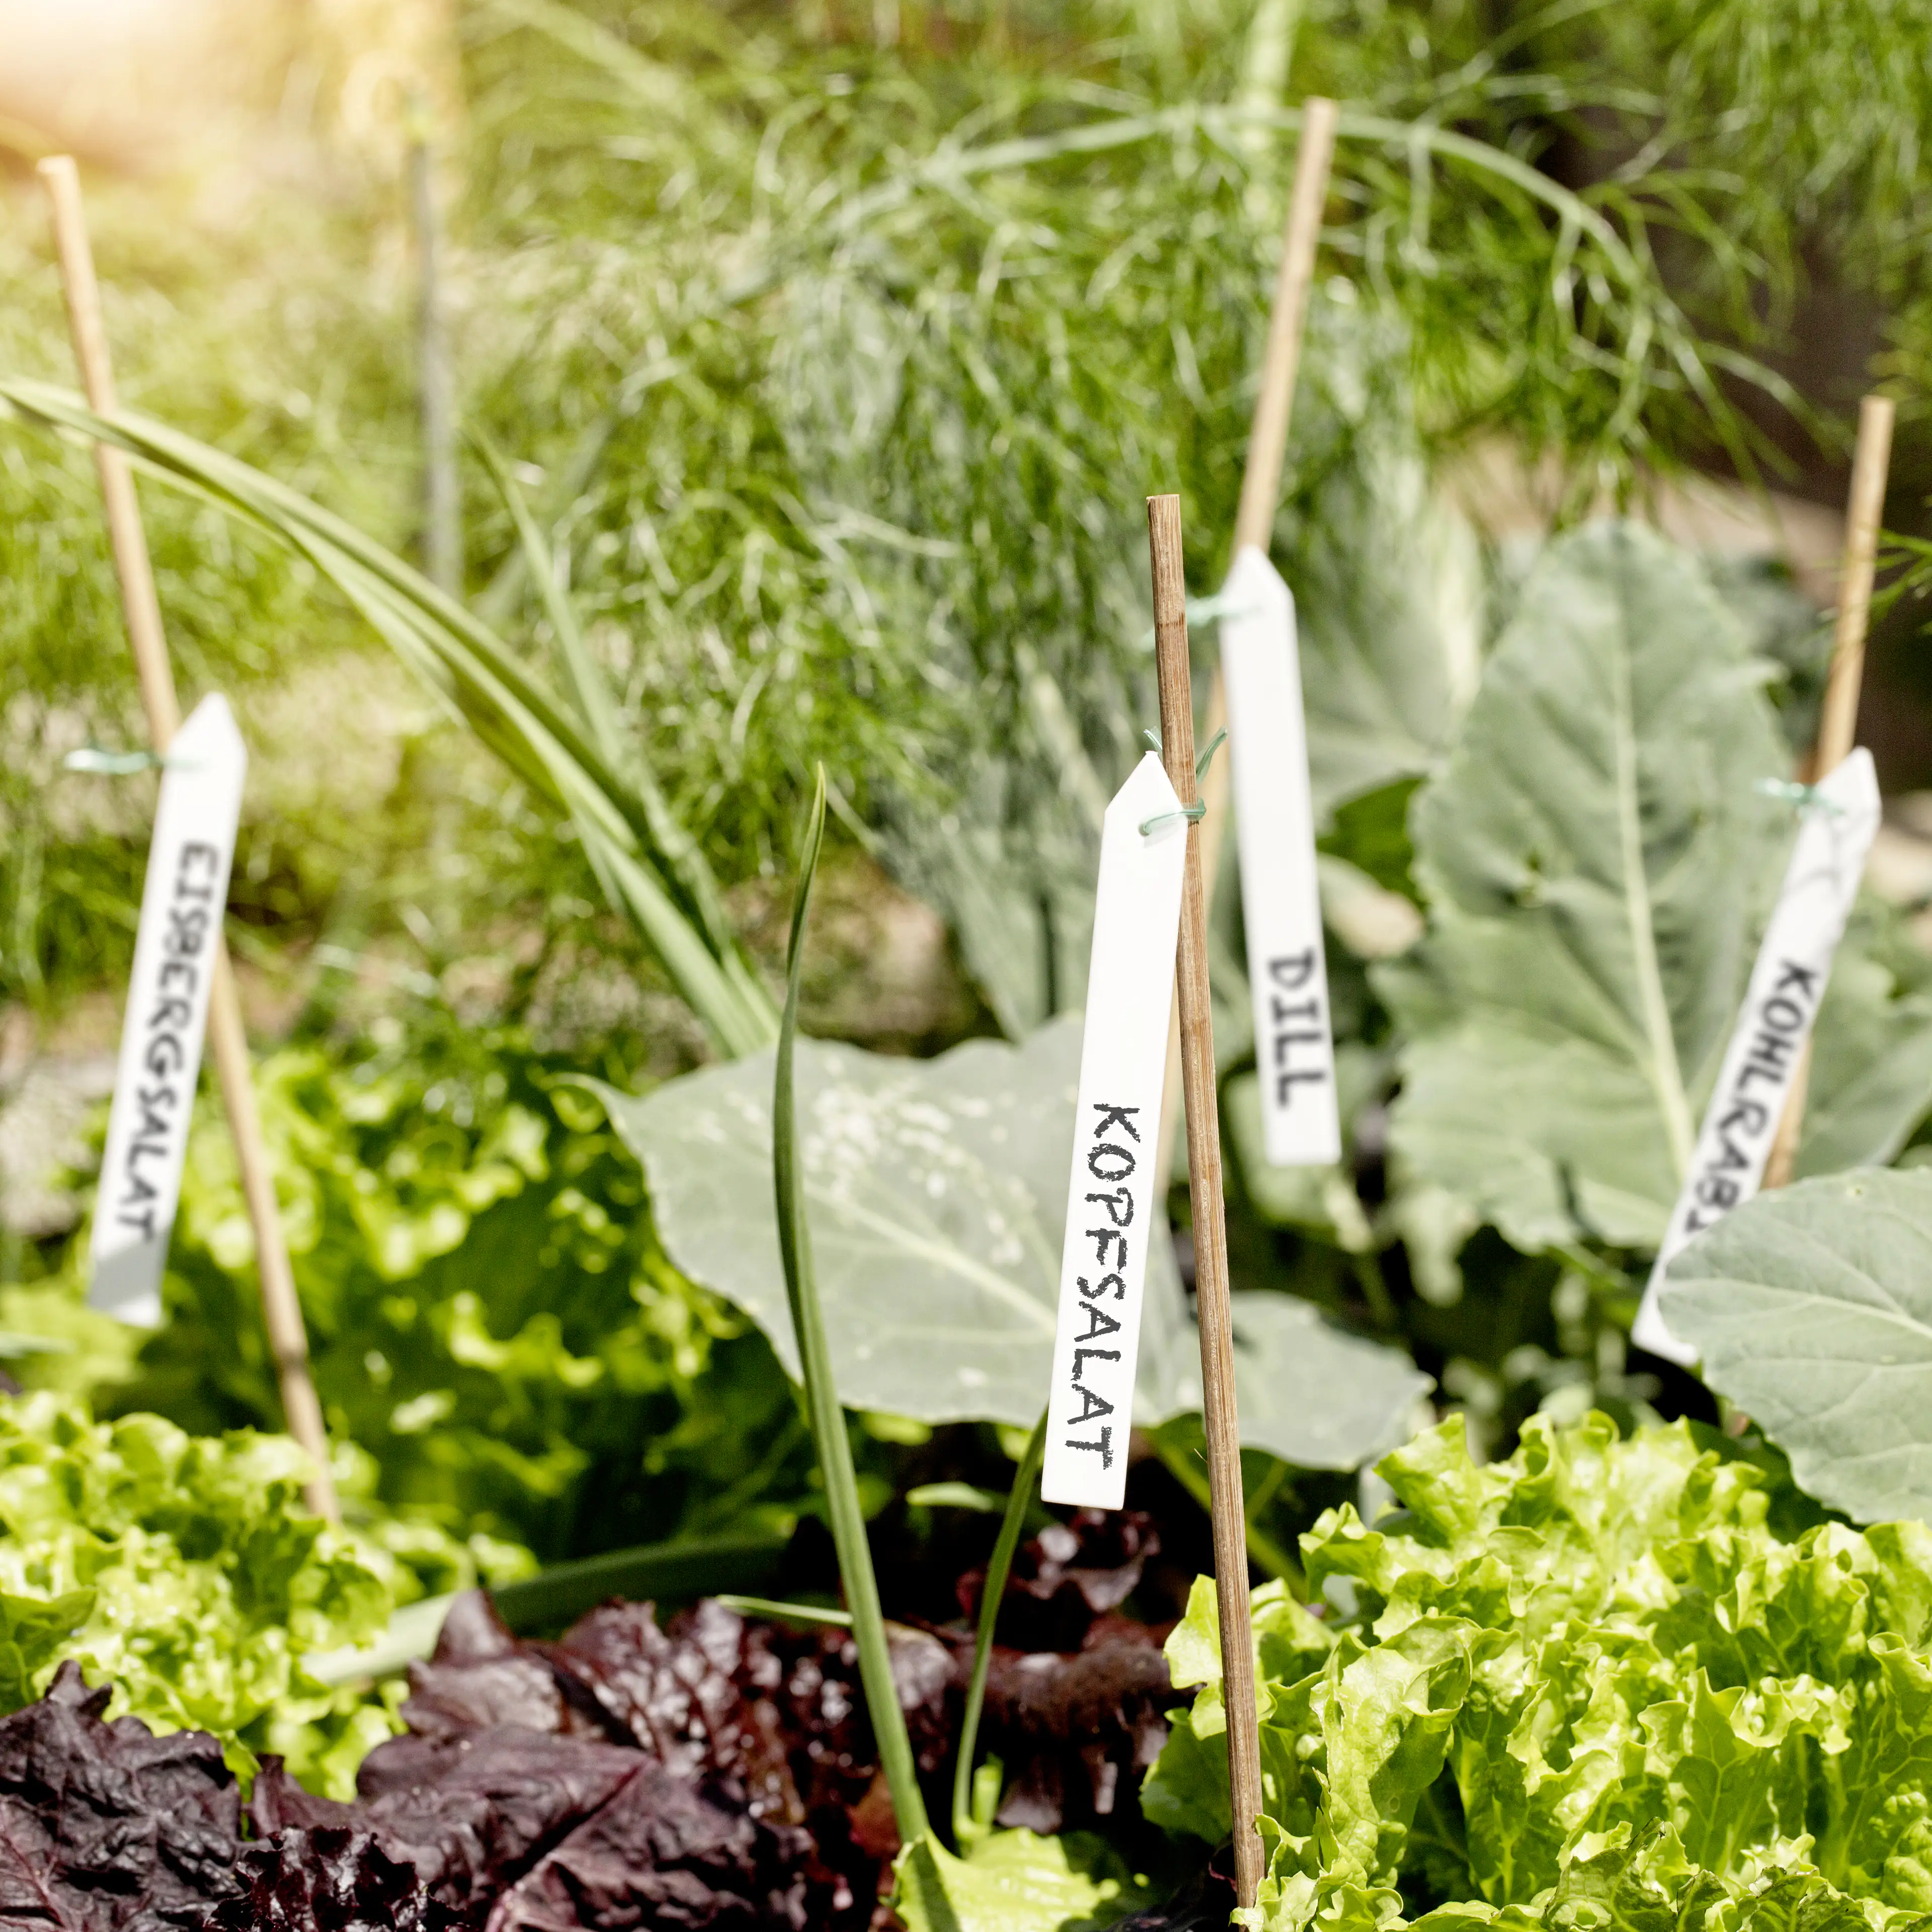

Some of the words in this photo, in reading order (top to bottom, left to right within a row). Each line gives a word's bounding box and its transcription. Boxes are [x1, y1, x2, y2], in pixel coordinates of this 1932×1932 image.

[117, 841, 219, 1243] EISBERGSALAT
[1268, 948, 1327, 1109] DILL
[1065, 1103, 1141, 1470] KOPFSALAT
